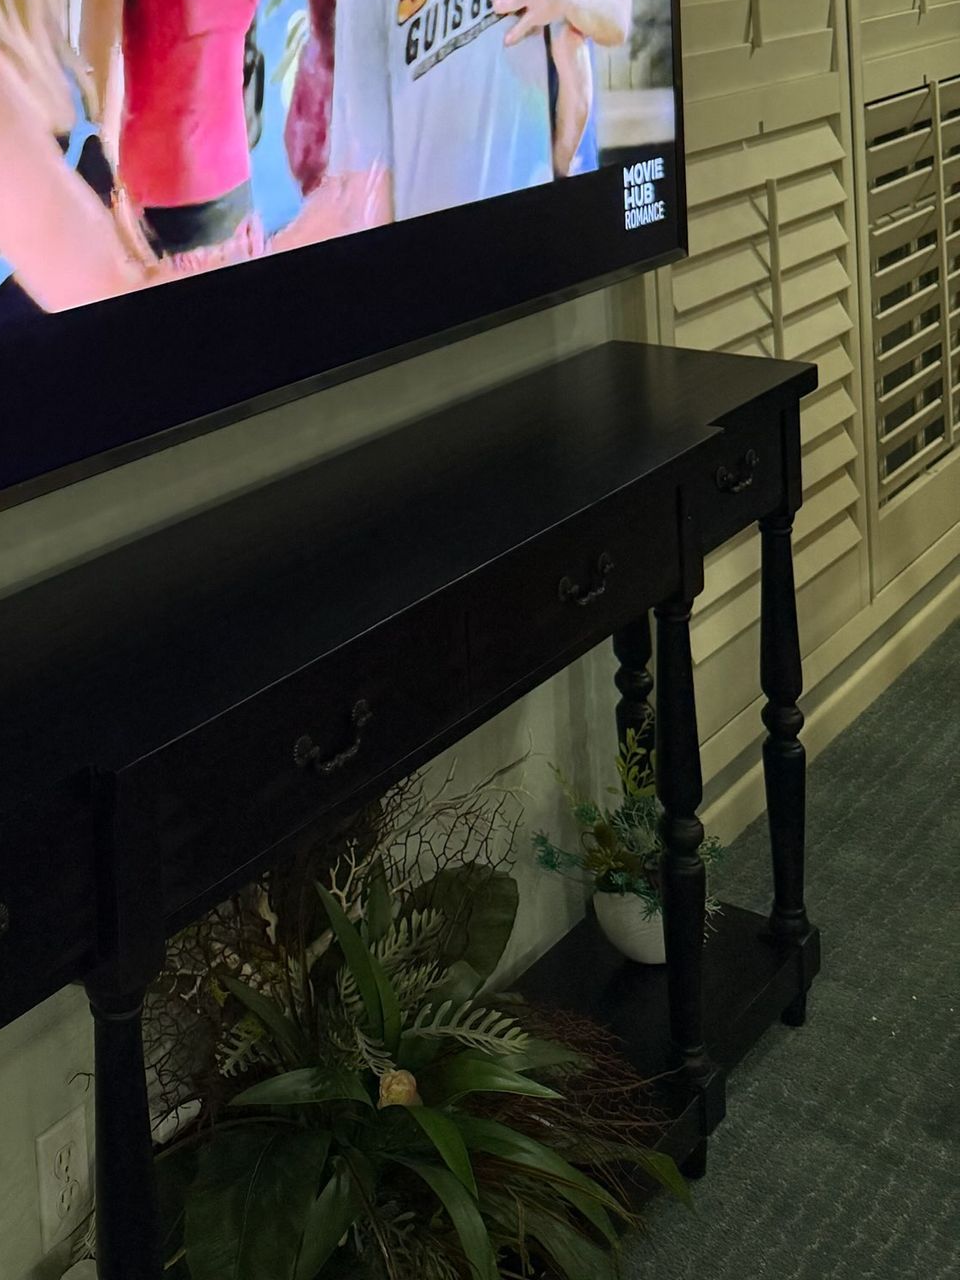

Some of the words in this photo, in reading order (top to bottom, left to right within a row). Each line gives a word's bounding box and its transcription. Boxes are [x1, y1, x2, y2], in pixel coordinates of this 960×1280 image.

[623, 157, 665, 188] MOVIE
[624, 182, 656, 210] HUB
[624, 200, 666, 231] ROMANCE
